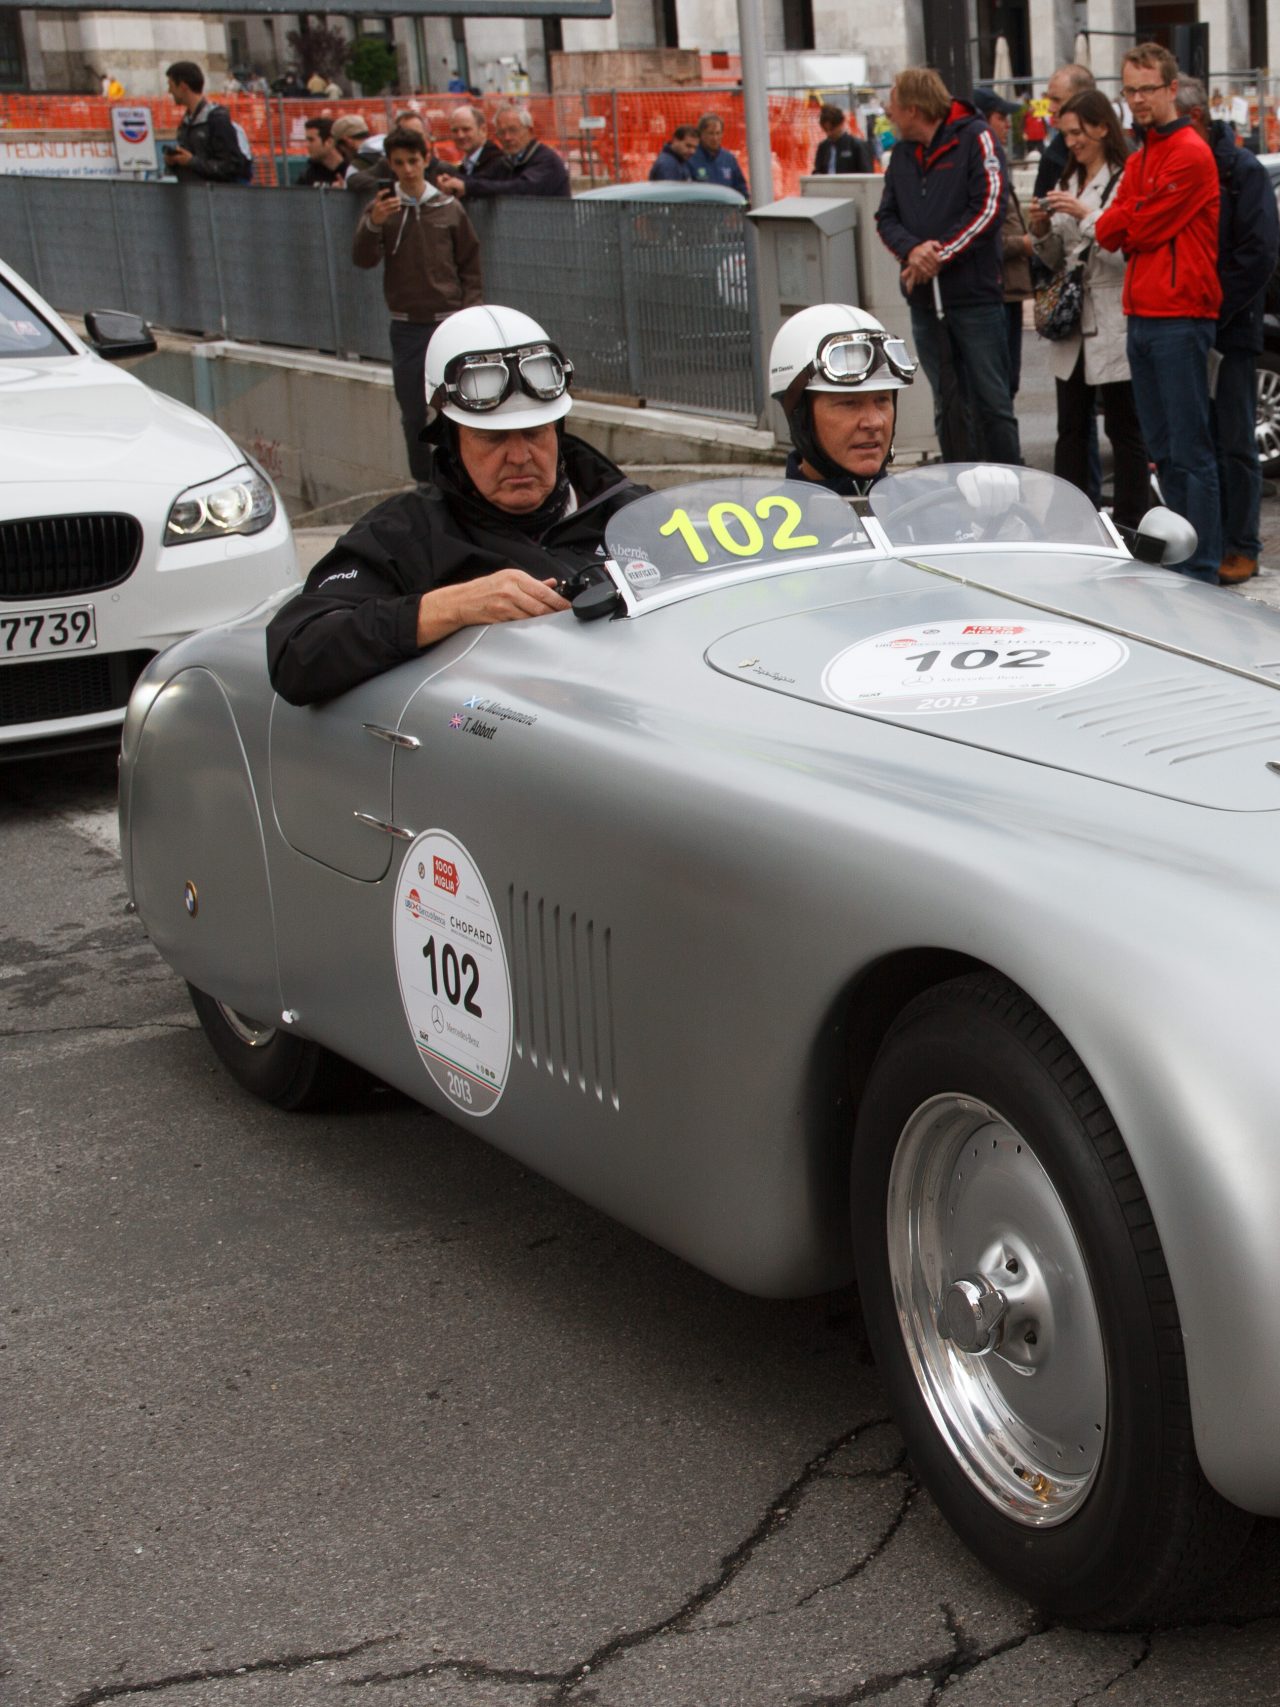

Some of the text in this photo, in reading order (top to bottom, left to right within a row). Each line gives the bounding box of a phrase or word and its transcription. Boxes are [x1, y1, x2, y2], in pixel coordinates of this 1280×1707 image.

[659, 495, 819, 563] 102
[1, 611, 91, 651] 7739
[905, 649, 1051, 672] 102
[916, 695, 978, 710] 2013
[435, 860, 453, 877] 1000
[450, 916, 492, 945] CHOPARD
[423, 935, 482, 1018] 102
[447, 1071, 473, 1104] 2013
